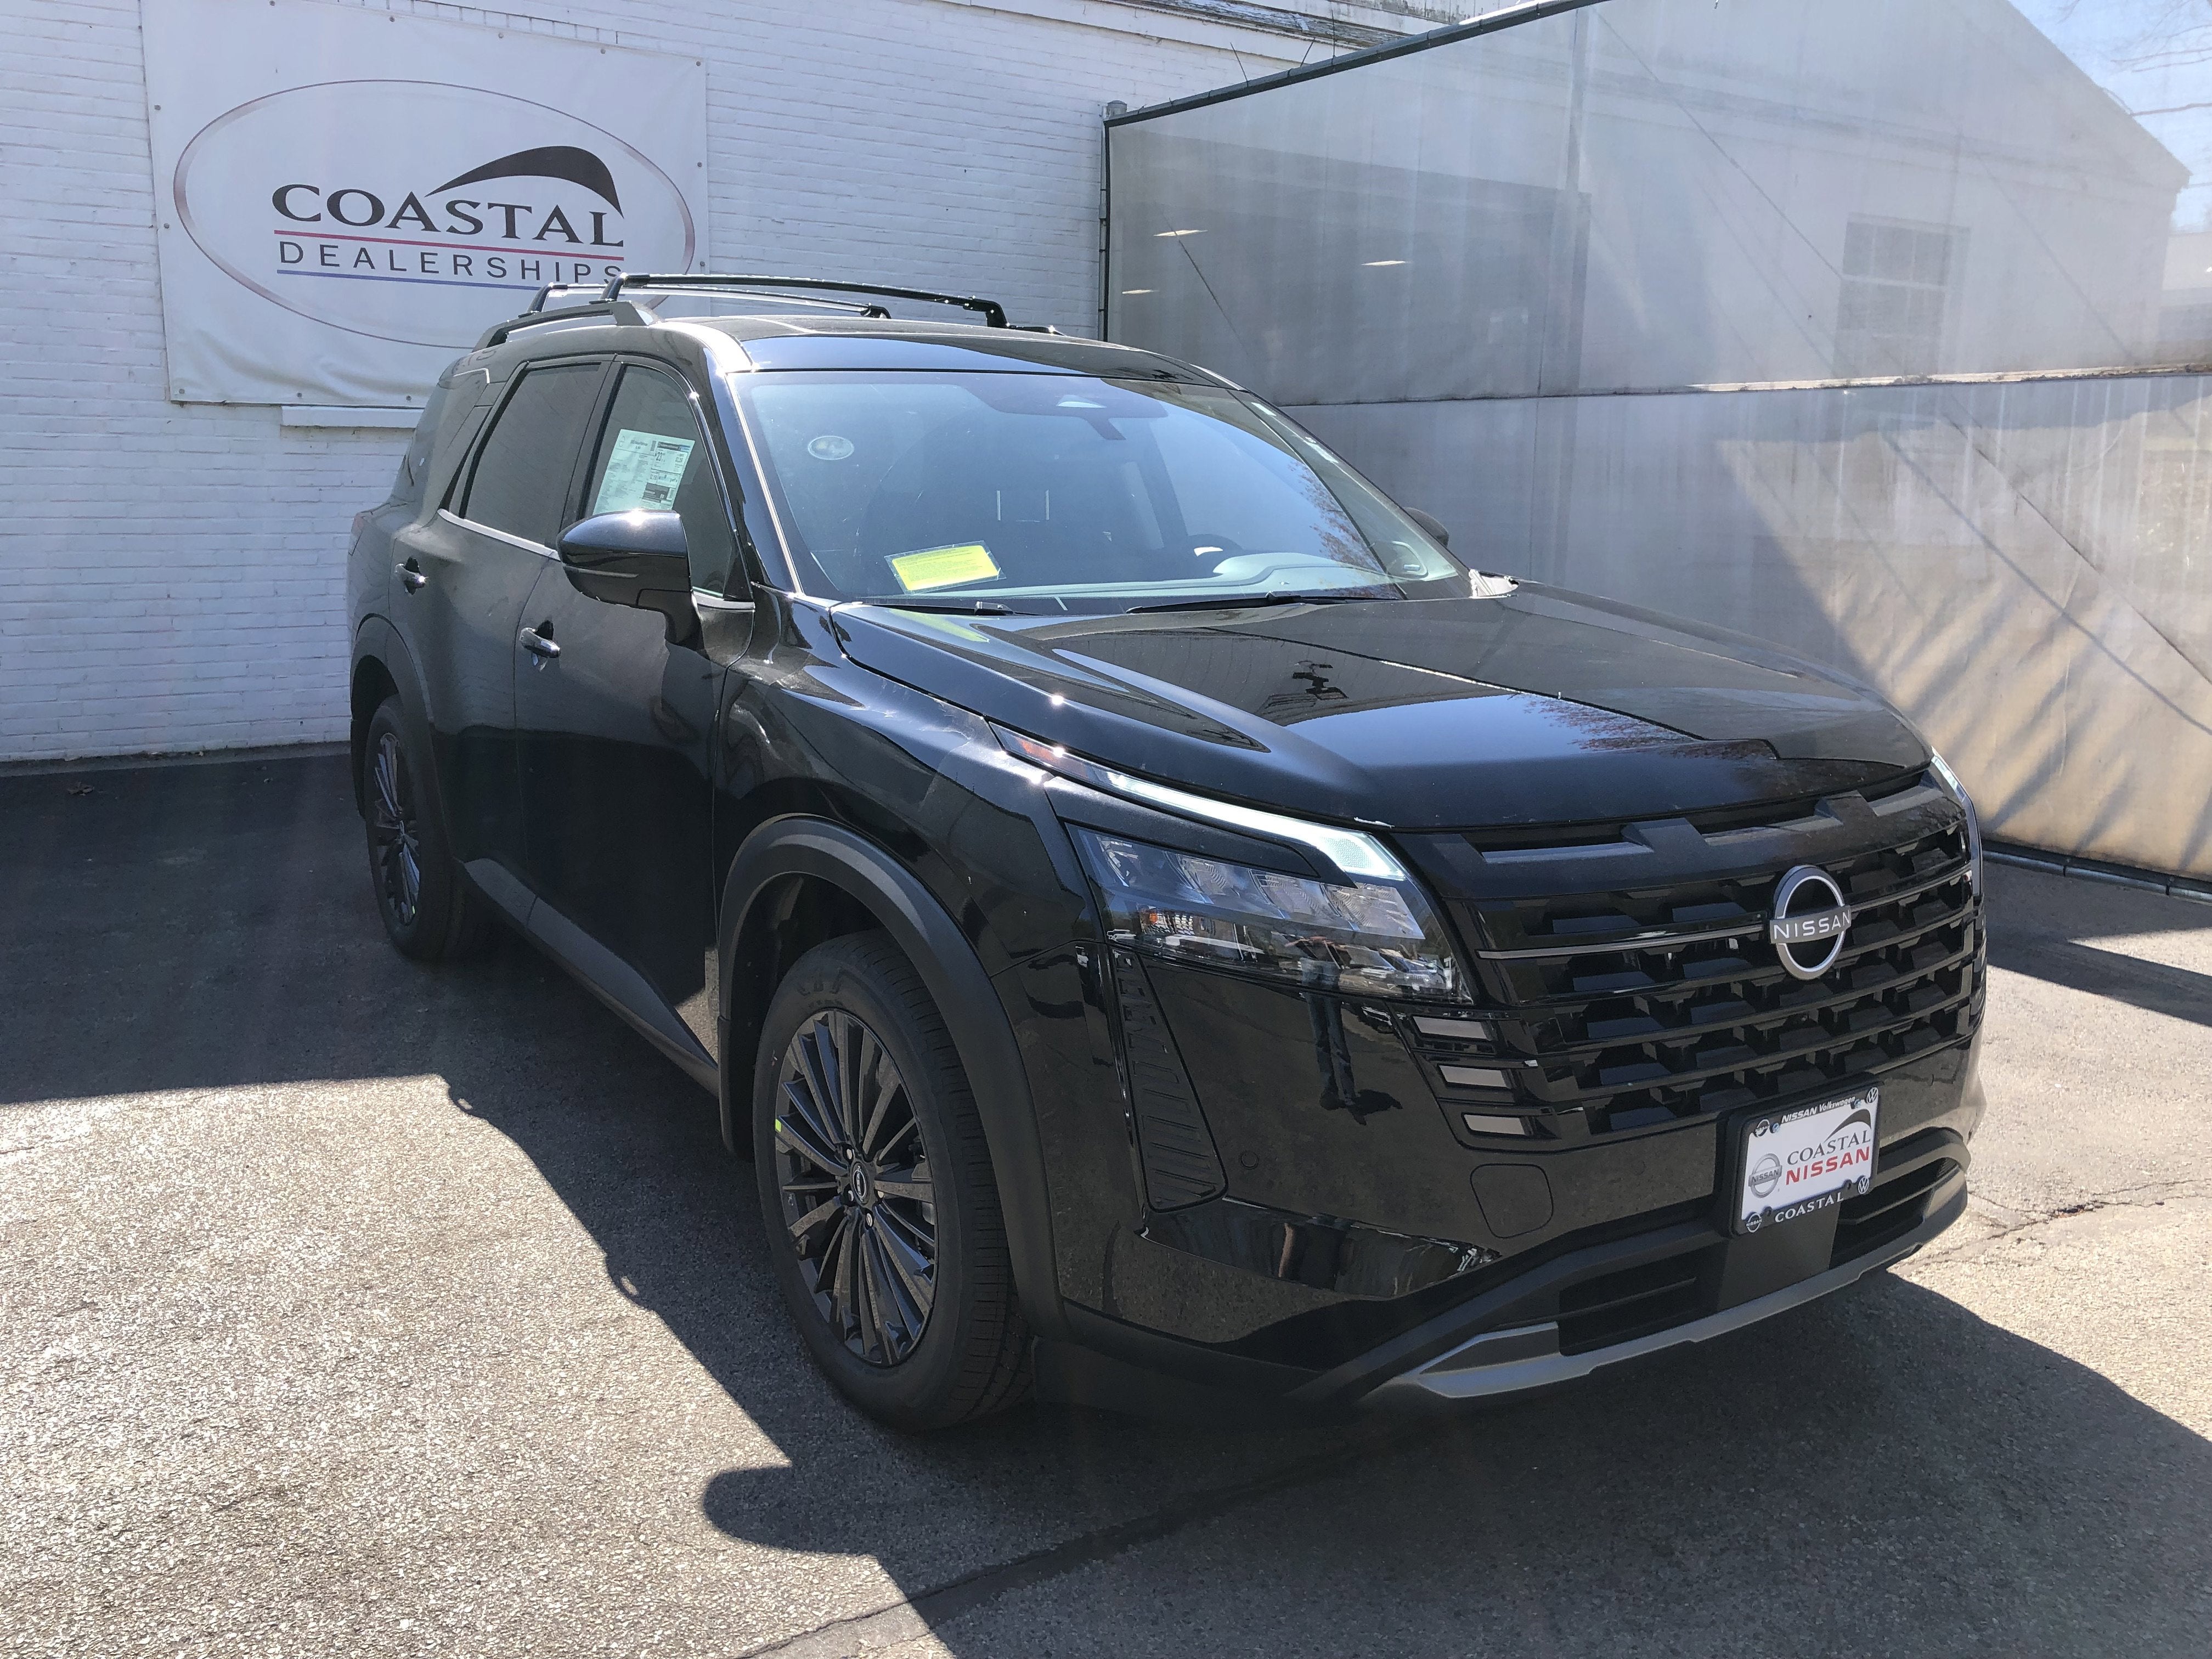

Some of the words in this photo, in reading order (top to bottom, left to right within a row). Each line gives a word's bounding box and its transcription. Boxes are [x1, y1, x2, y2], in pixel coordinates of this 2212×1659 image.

[272, 183, 624, 247] COASTAL
[280, 241, 621, 284] DEALERSHIPS
[1774, 910, 1850, 940] NISSAN
[1781, 1106, 1818, 1124] NISSAN
[1819, 1096, 1855, 1112] Volkswagen
[1787, 1130, 1871, 1165] COASTAL
[1751, 1169, 1779, 1183] NISSAN
[1786, 1146, 1870, 1185] NISSAN
[1775, 1192, 1844, 1223] COASTAL
